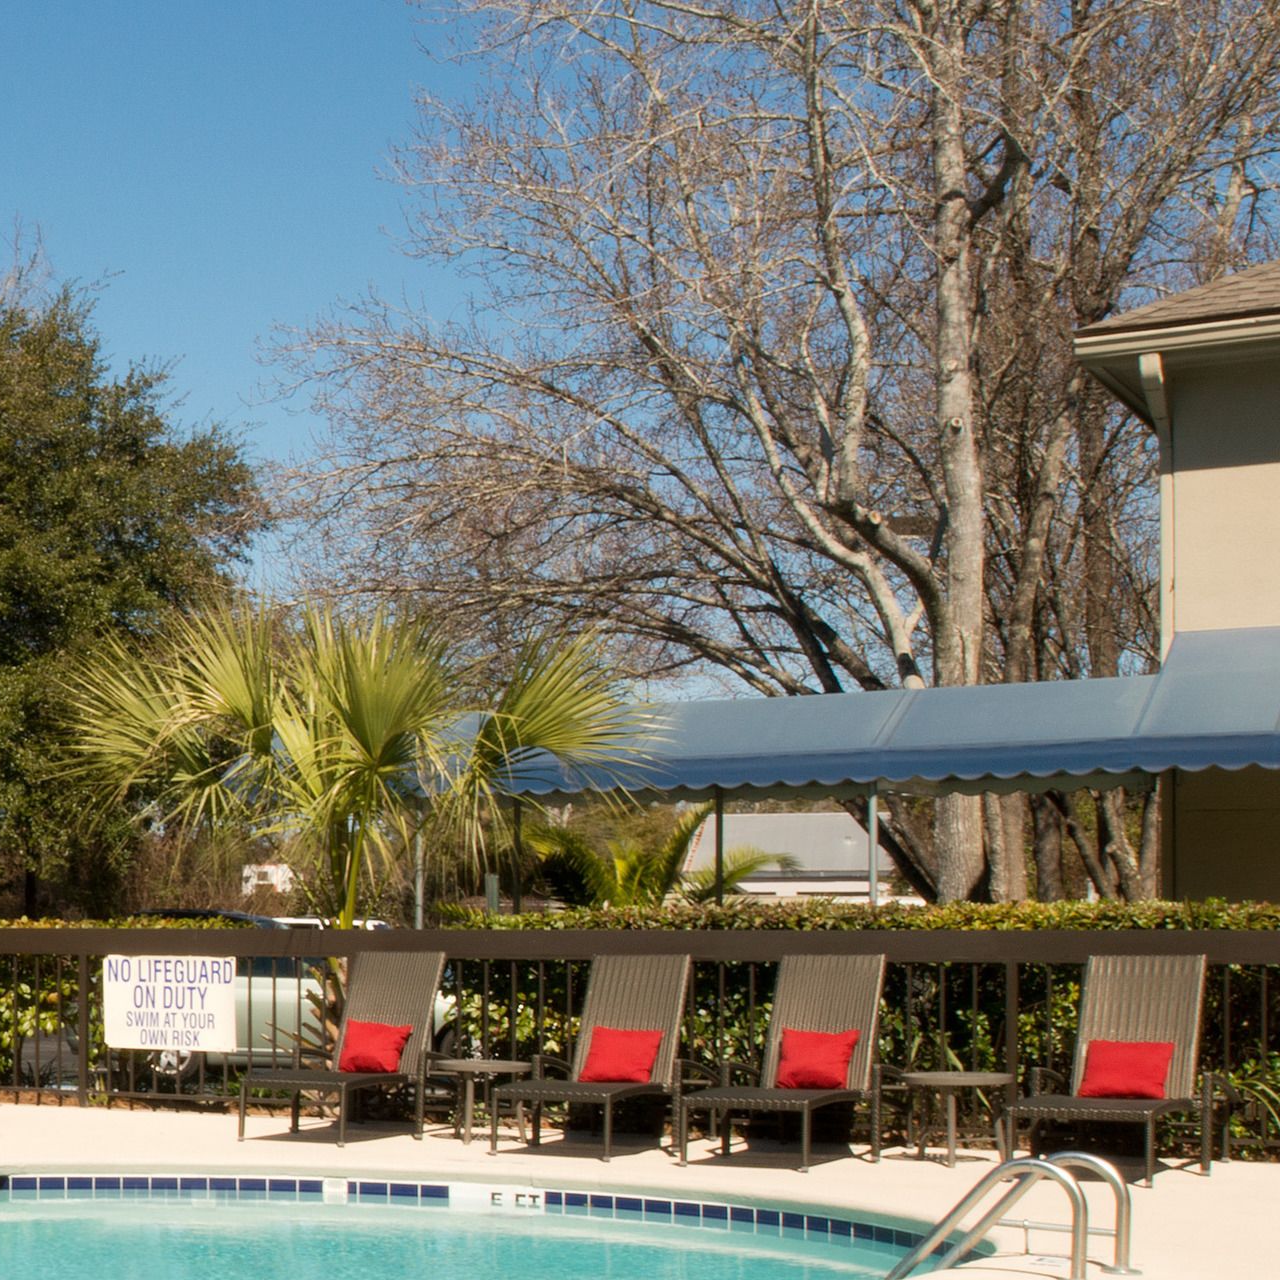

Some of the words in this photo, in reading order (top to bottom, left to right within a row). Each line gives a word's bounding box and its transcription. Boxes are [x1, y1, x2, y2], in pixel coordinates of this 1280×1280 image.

[108, 959, 131, 982] NO
[138, 959, 233, 984] LIFEGUARD
[133, 985, 155, 1008] ON
[163, 986, 207, 1010] DUTY
[126, 1011, 159, 1027] SWIM
[163, 1012, 177, 1028] AT
[181, 1012, 215, 1029] YOUR
[140, 1029, 167, 1045] OWN
[172, 1030, 200, 1047] RISK
